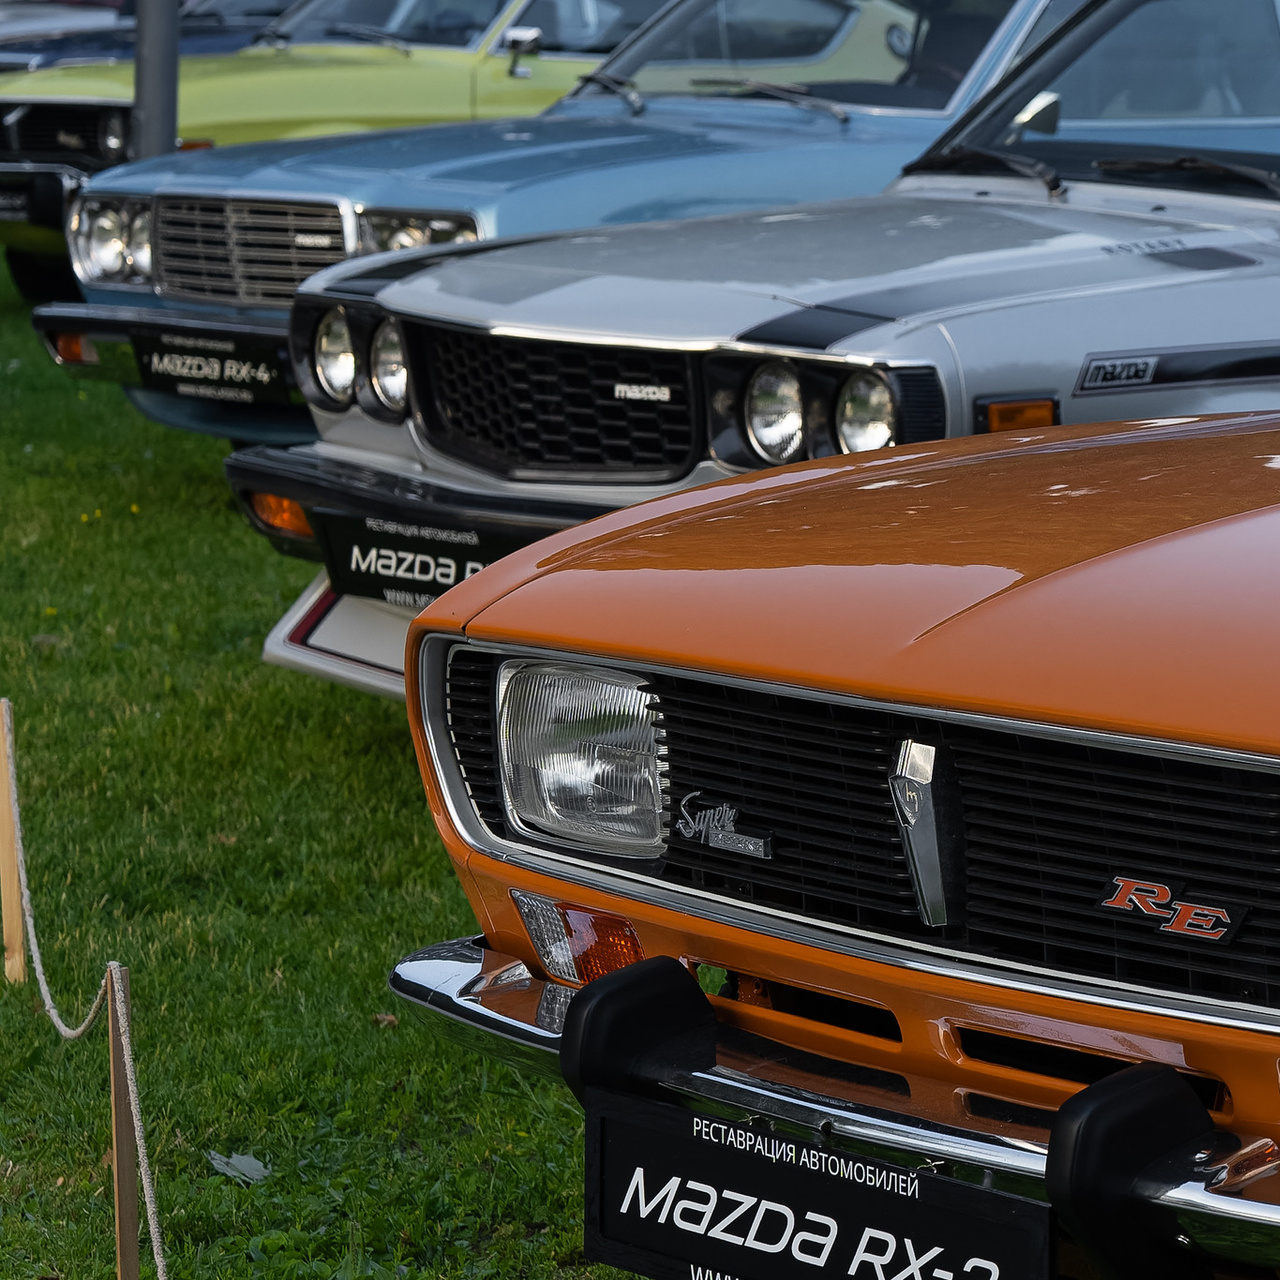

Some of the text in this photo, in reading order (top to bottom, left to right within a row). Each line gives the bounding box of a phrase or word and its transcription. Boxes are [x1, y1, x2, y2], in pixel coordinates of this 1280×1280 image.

[1101, 876, 1231, 940] RE
[693, 1117, 920, 1199] РЕСТАВРАЦИЯ АВТОМОБИЛЕЙ
